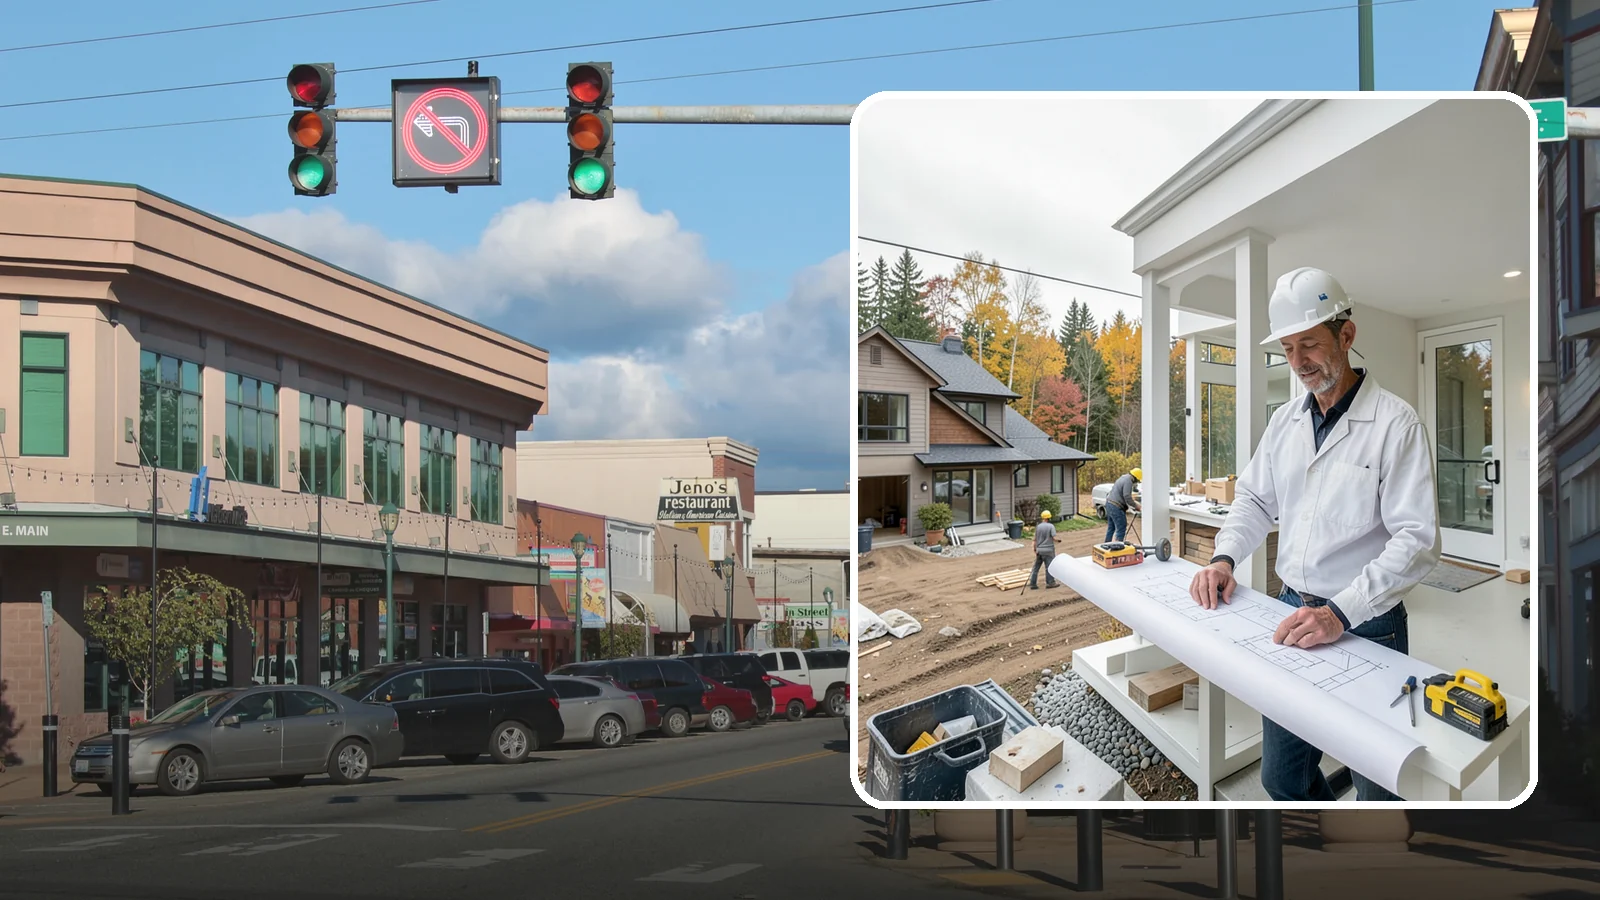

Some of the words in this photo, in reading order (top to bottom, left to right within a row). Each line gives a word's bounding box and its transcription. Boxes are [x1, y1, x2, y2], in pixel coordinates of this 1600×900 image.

[670, 480, 727, 494] Jeno's
[665, 496, 731, 509] restaurant
[658, 510, 682, 519] Italian
[686, 509, 714, 519] American
[715, 509, 737, 519] Cuisine
[2, 525, 13, 536] E.
[15, 525, 49, 536] MAIN
[797, 607, 828, 616] Street
